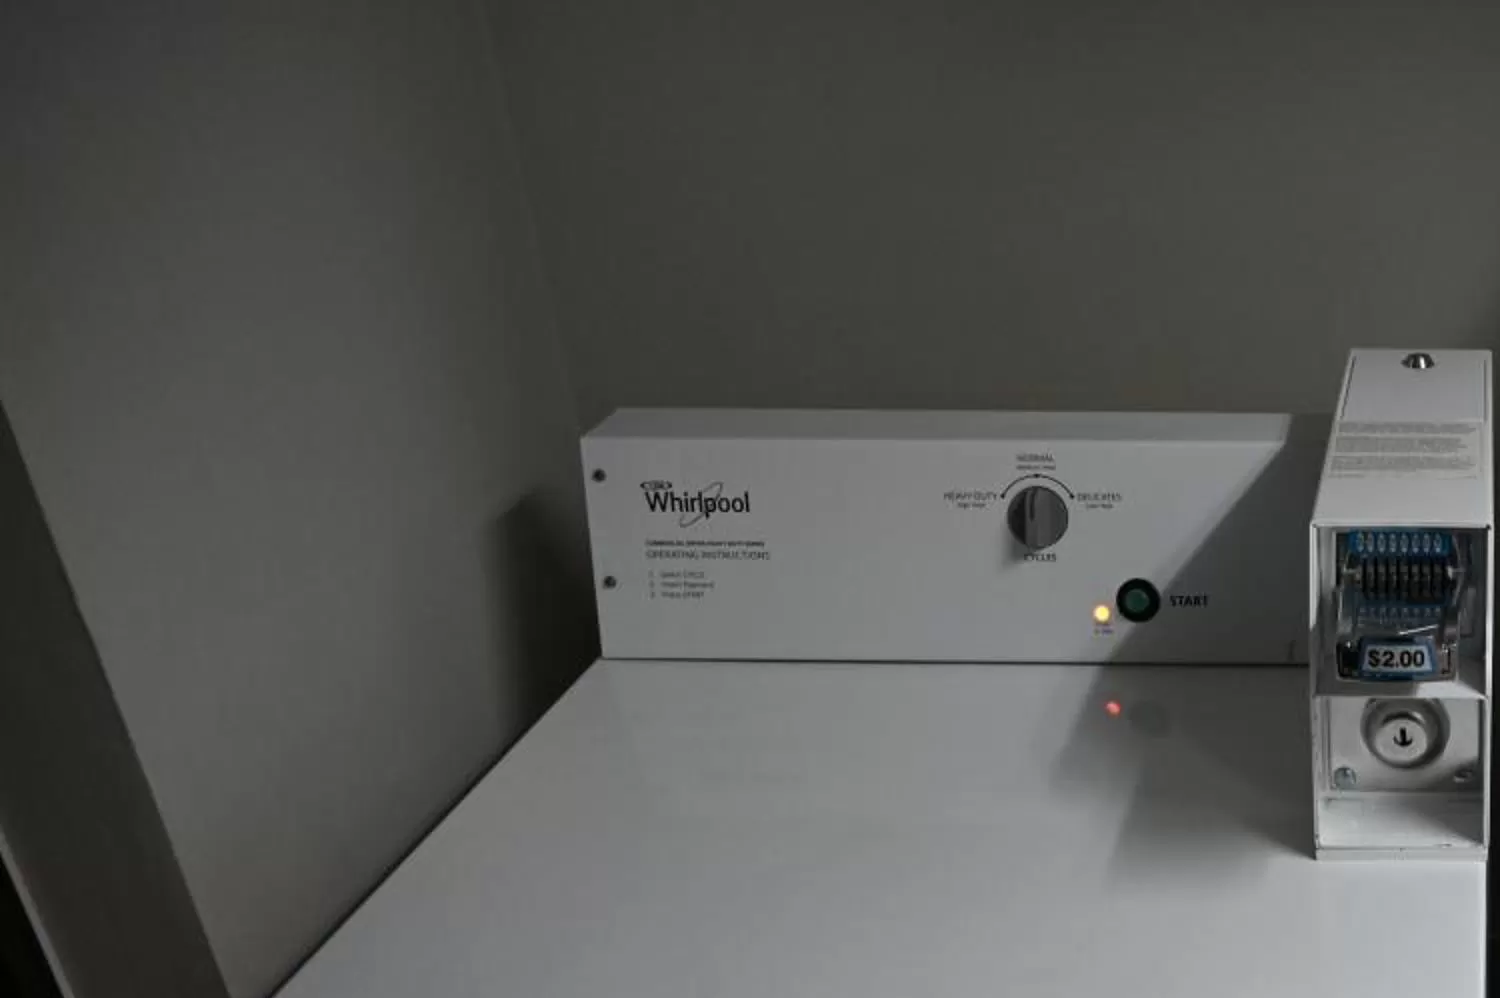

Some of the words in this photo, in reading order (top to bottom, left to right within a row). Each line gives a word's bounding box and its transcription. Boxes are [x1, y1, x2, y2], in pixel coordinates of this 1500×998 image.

[644, 490, 751, 520] Whirlpool
[1170, 595, 1209, 607] START
[1367, 650, 1425, 668] $2.00
